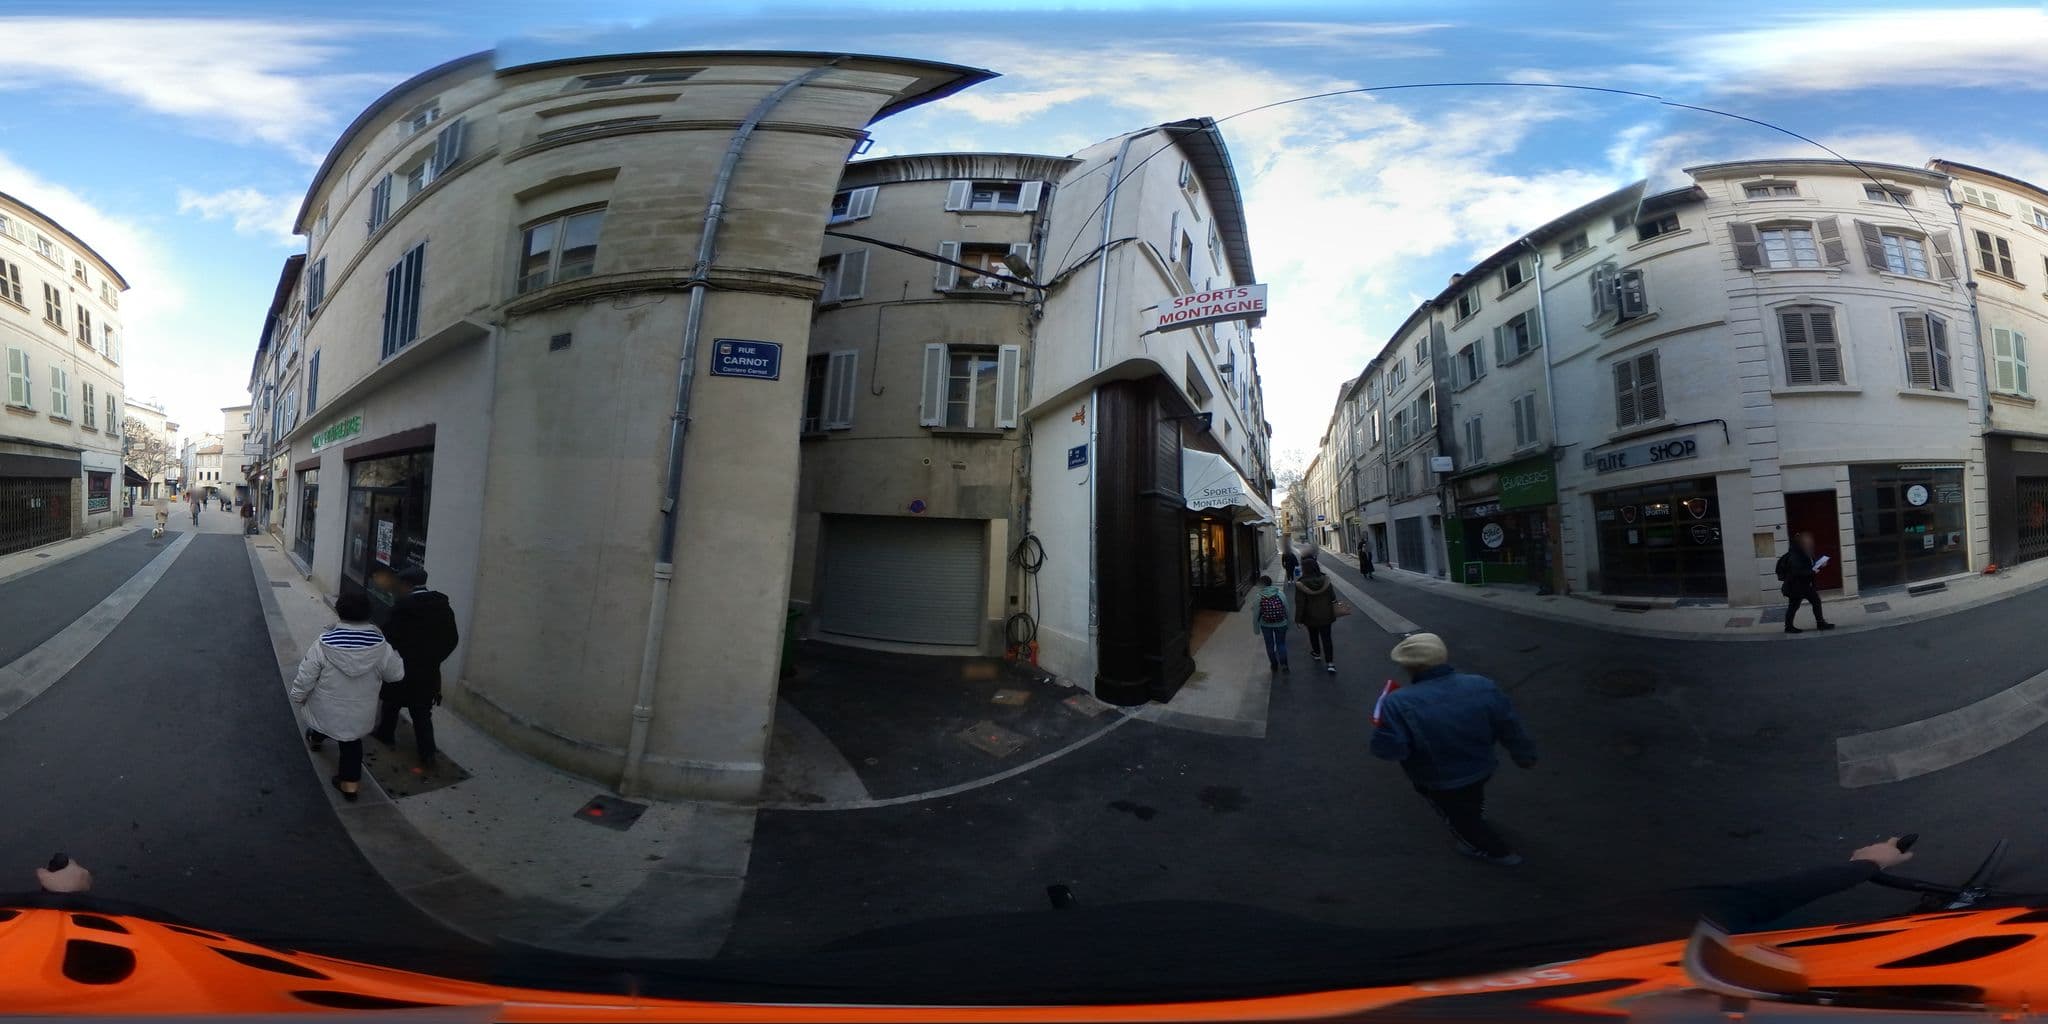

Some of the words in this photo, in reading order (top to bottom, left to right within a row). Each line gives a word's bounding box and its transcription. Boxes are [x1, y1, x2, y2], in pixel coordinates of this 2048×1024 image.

[1174, 288, 1248, 308] SPORTS
[1160, 299, 1263, 324] MONTAGNE
[738, 346, 756, 354] RUE
[724, 356, 769, 366] CARNOT
[1649, 440, 1696, 462] SHOP
[1203, 487, 1238, 496] SPORTS
[1193, 497, 1240, 508] MONTAGNE
